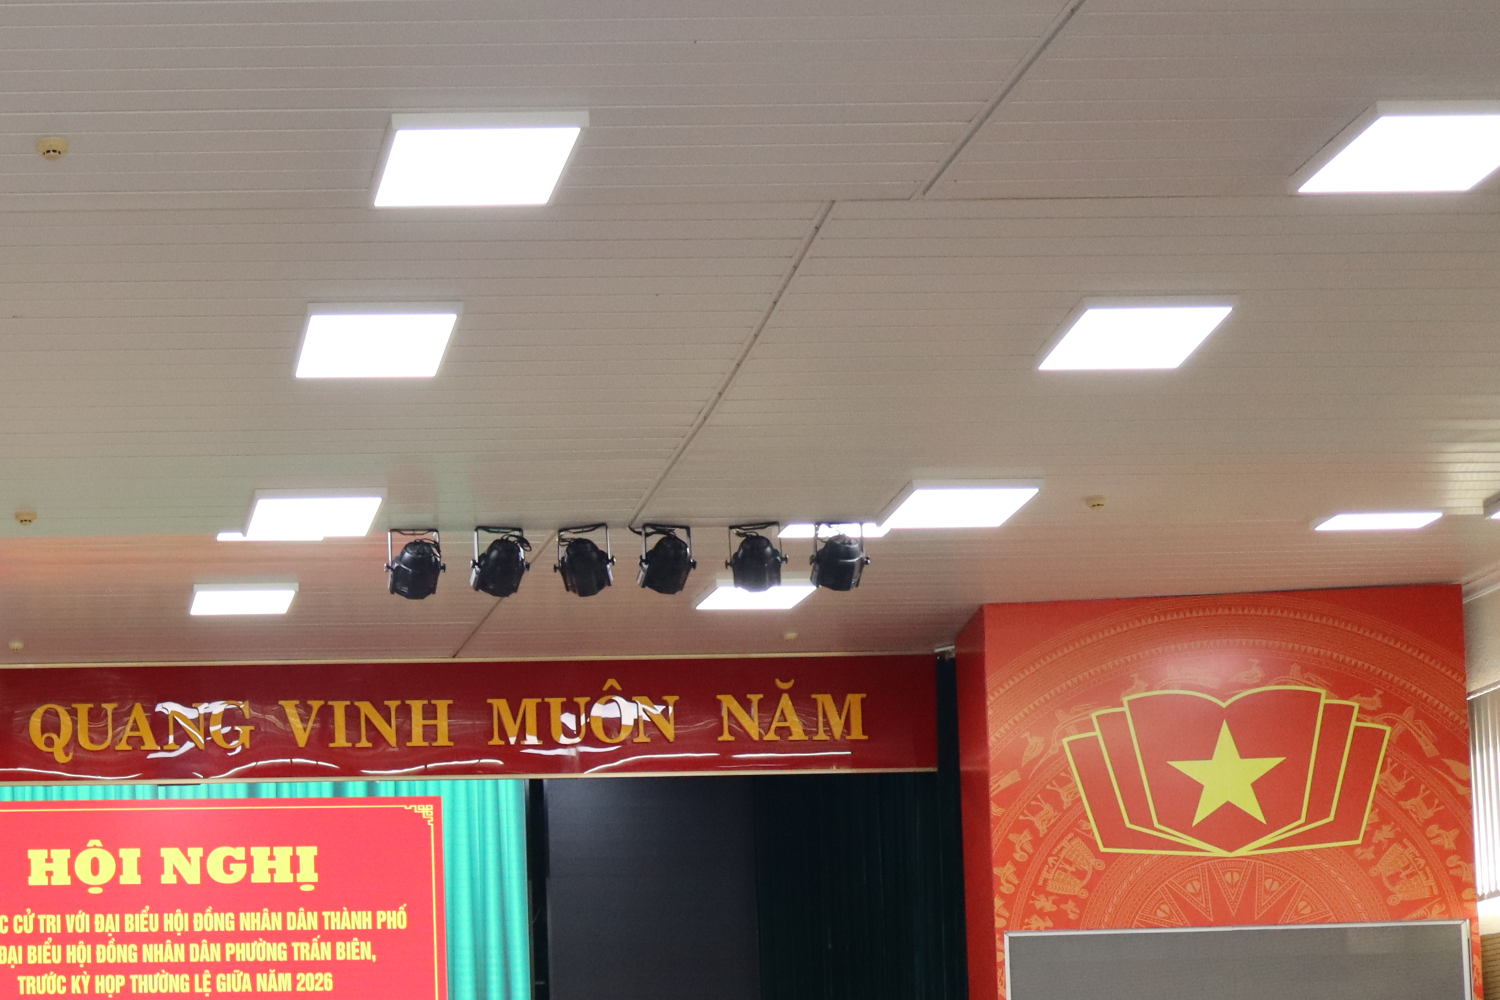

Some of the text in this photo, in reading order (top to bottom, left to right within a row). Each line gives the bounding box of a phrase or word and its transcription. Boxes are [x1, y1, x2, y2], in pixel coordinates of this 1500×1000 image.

[28, 700, 255, 764] QUANG
[279, 699, 454, 748] VINH
[486, 678, 680, 745] MUÔN
[716, 678, 869, 742] NĂM
[27, 839, 319, 894] HỘI NGHỊ
[13, 908, 36, 934] CỬ
[37, 914, 61, 934] TRI
[66, 910, 91, 933] VỚI
[94, 914, 120, 937] ĐẠI
[124, 905, 159, 933] BIỂU
[164, 908, 189, 936] HỘI
[193, 906, 235, 932] ĐỒNG
[239, 908, 282, 931] NHÂN
[286, 907, 318, 931] DÂN
[322, 906, 373, 930] THÀNH
[376, 903, 408, 930] PHỐ
[27, 937, 62, 965] BIỂU
[66, 941, 92, 968] HỘI
[96, 938, 138, 964] ĐỒNG
[142, 940, 185, 963] NHÂN
[190, 939, 222, 962] DÂN
[225, 938, 288, 962] PHƯỜNG
[291, 935, 332, 961] TRẤN
[336, 937, 377, 963] BIÊN,
[17, 968, 334, 998] TRƯỚC KỲ HỌP THƯỜNG LỆ GIỮA NĂM 2026
